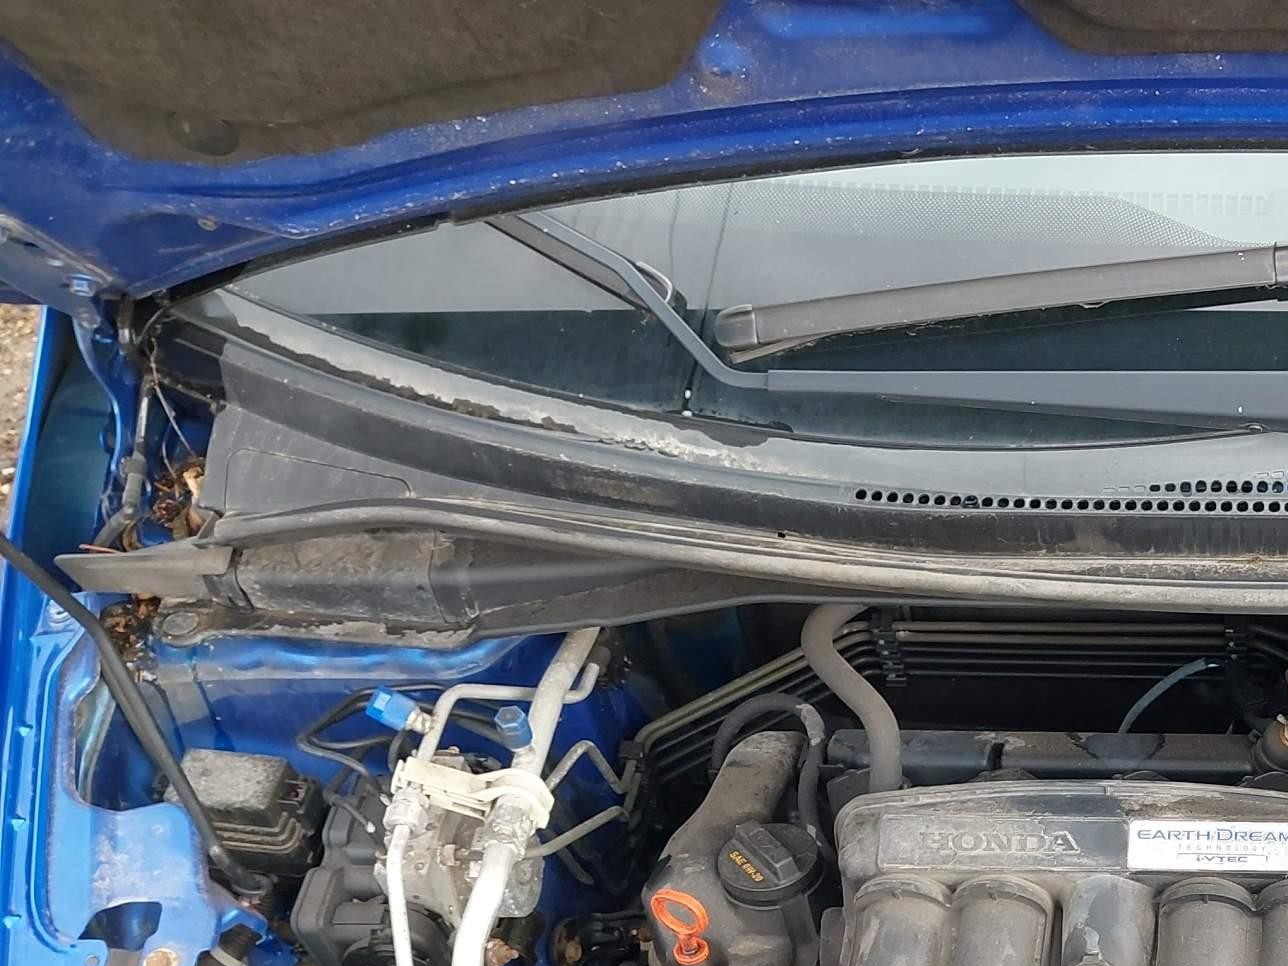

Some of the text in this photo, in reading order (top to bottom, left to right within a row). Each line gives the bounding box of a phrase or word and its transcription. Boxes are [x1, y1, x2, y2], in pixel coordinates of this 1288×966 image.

[1137, 829, 1211, 841] EARTH
[919, 830, 1081, 853] HONDA
[1178, 844, 1266, 852] TECHNOLOGY
[729, 851, 748, 866] SAE
[1196, 855, 1249, 863] i-VTEC
